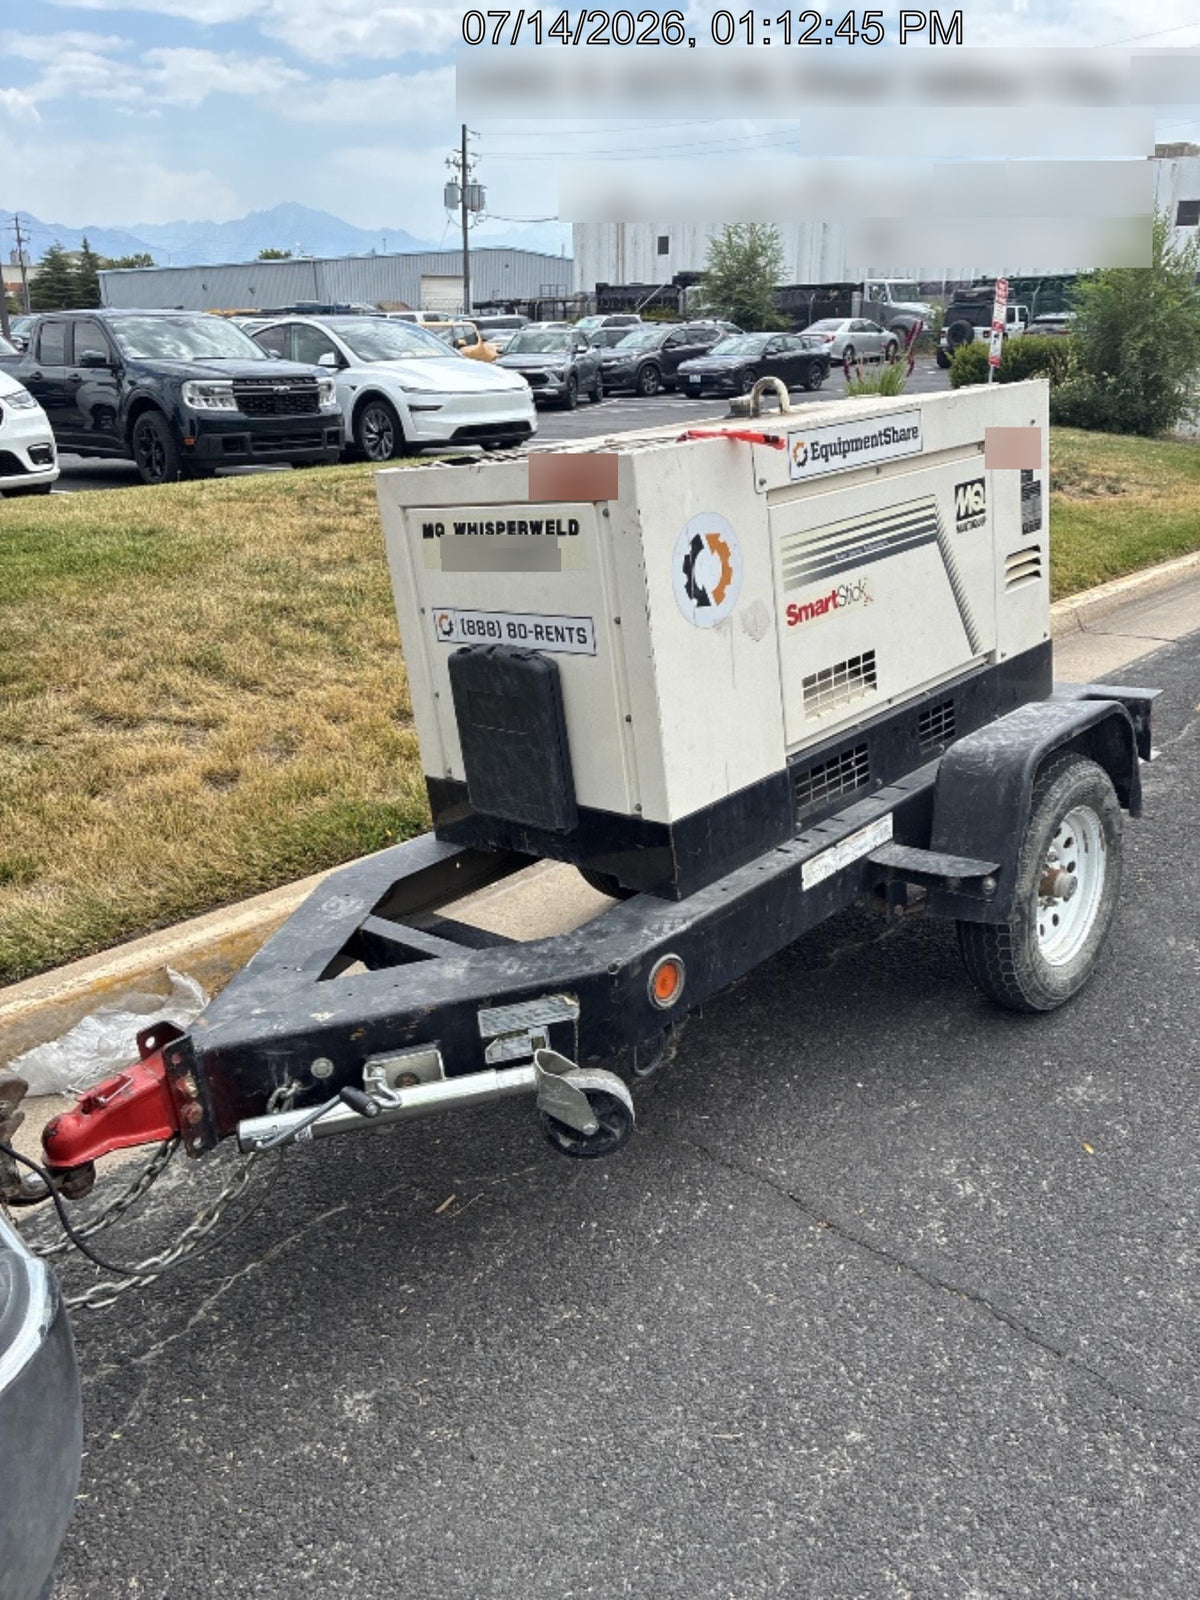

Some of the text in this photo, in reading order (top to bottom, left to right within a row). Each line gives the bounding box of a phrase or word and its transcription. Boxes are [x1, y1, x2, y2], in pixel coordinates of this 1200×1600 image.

[810, 425, 919, 463] EquipmentShare
[422, 519, 580, 539] MQ WHISPERWELD
[786, 579, 867, 626] SmartStick
[461, 618, 588, 644] (888) 80-RENTS
